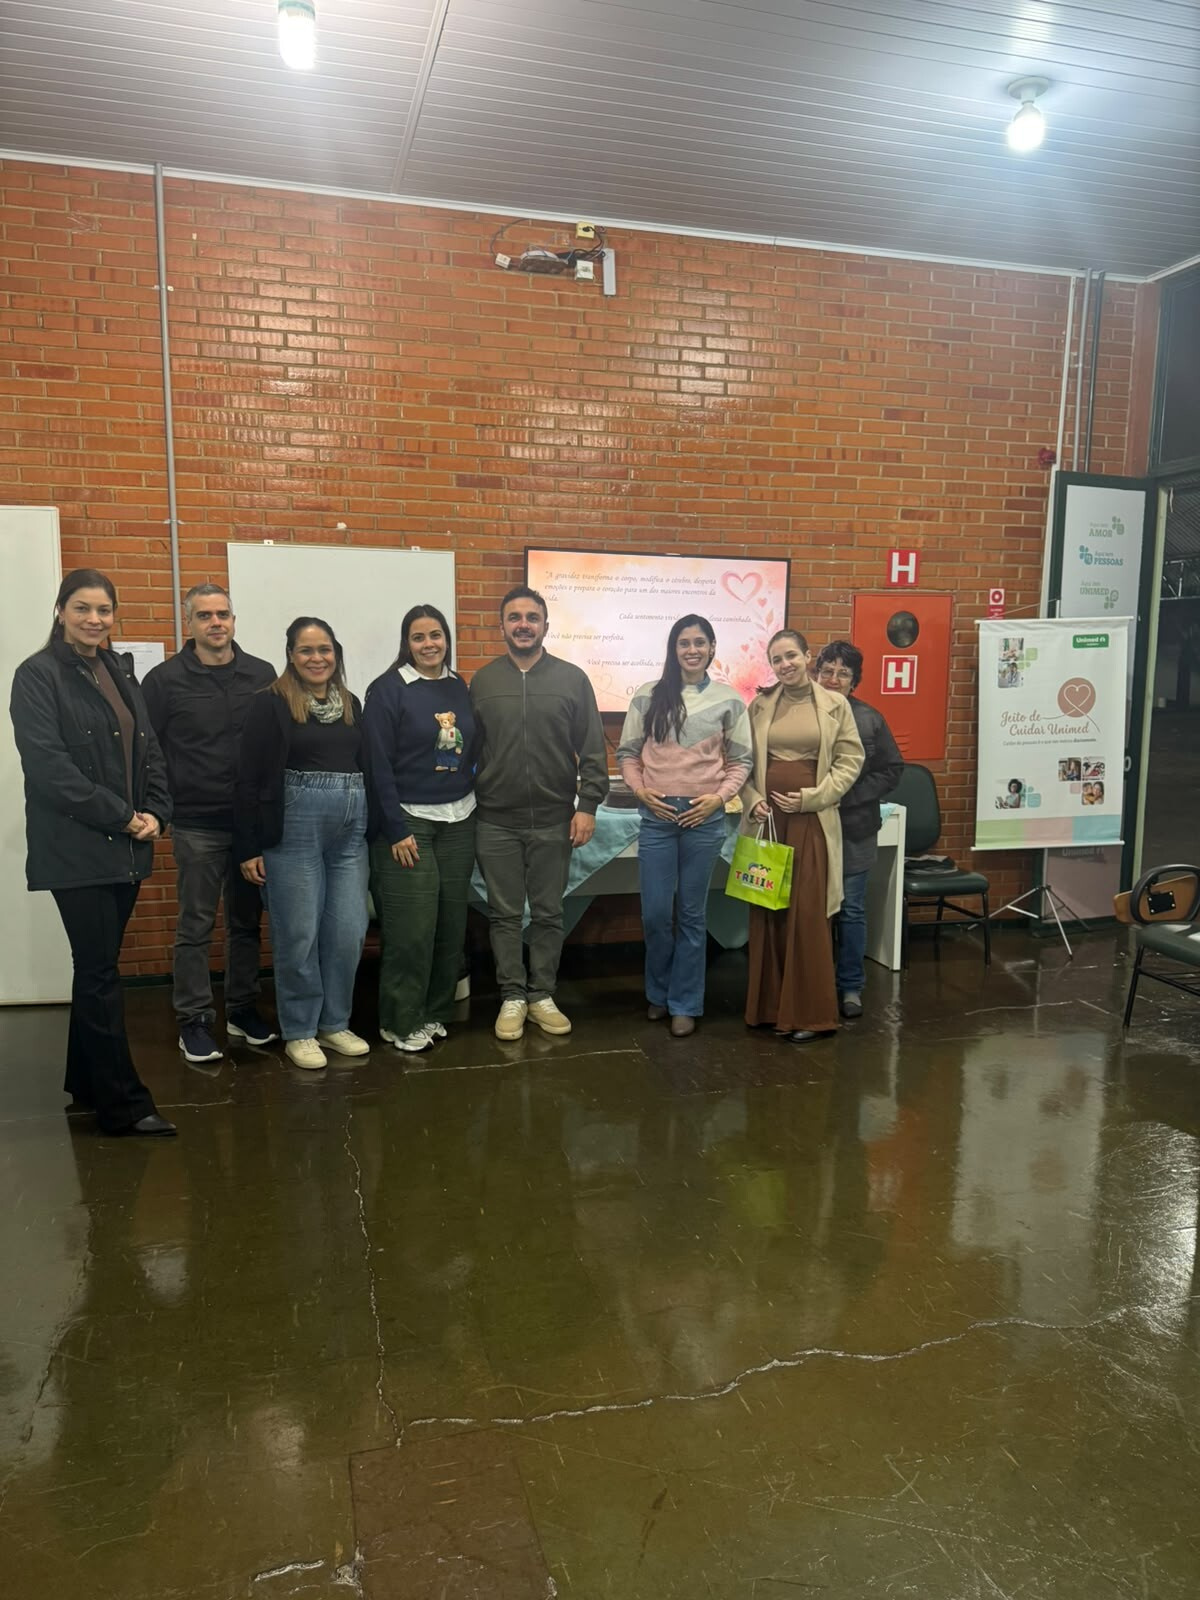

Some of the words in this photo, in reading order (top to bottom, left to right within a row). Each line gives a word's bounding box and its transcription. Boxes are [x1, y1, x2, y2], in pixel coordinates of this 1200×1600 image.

[1089, 528, 1113, 538] AMOR
[1094, 557, 1124, 566] PESSOAS
[891, 552, 916, 583] H
[582, 573, 613, 582] transforma
[640, 576, 664, 585] modifica
[545, 584, 568, 592] emoções
[602, 586, 623, 594] coração
[624, 587, 638, 595] para
[660, 587, 681, 595] maiores
[1080, 587, 1109, 596] UNIMED
[619, 612, 634, 620] Cada
[573, 633, 593, 642] precisa
[602, 660, 621, 668] precisa
[887, 662, 910, 688] H
[1000, 711, 1026, 727] Jeito
[1029, 709, 1041, 722] de
[1009, 723, 1045, 736] Cuidar
[1047, 721, 1089, 735] Unimed
[735, 870, 774, 890] TRIIIK
